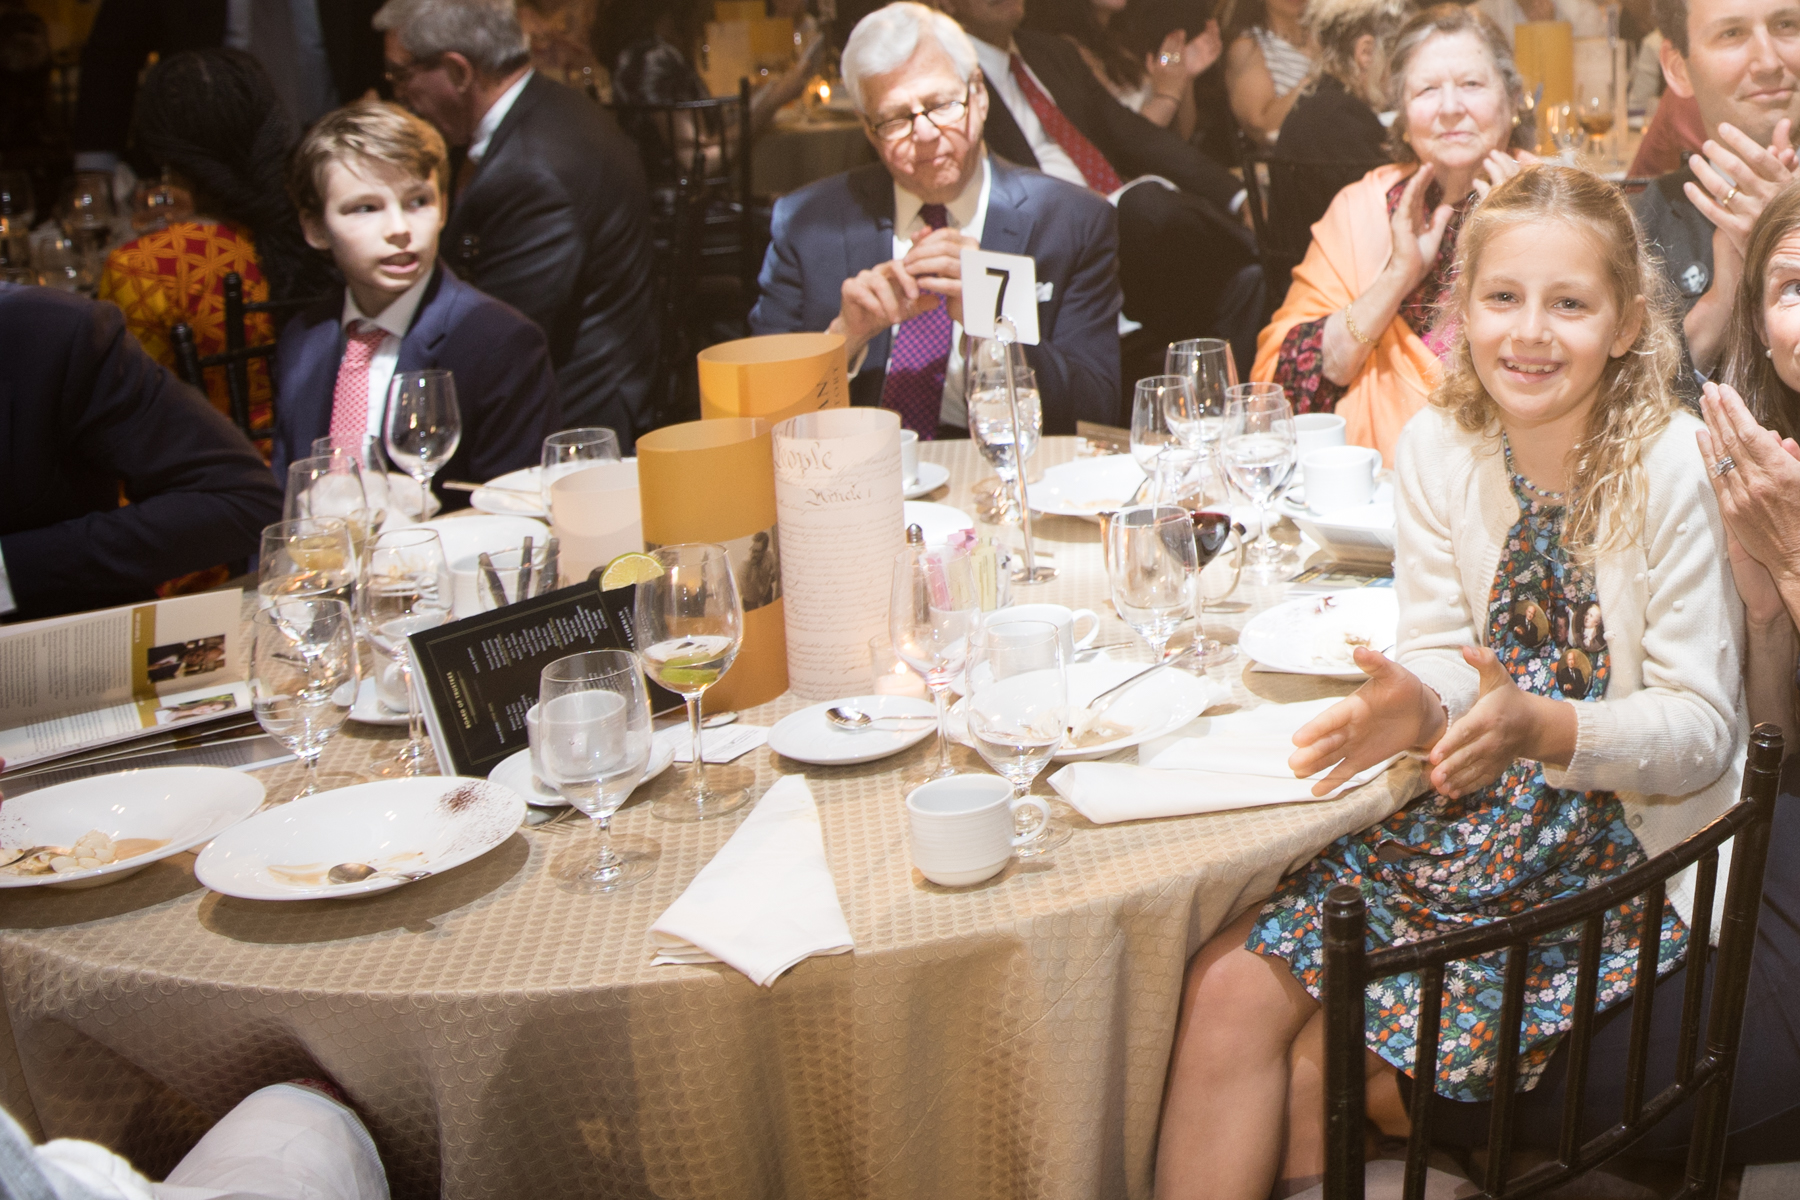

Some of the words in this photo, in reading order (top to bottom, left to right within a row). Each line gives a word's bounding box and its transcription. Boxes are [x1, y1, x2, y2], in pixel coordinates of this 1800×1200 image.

[985, 267, 1010, 323] 7
[446, 671, 461, 699] TRUSTEES
[456, 699, 465, 708] OF
[458, 707, 472, 729] BOARD
